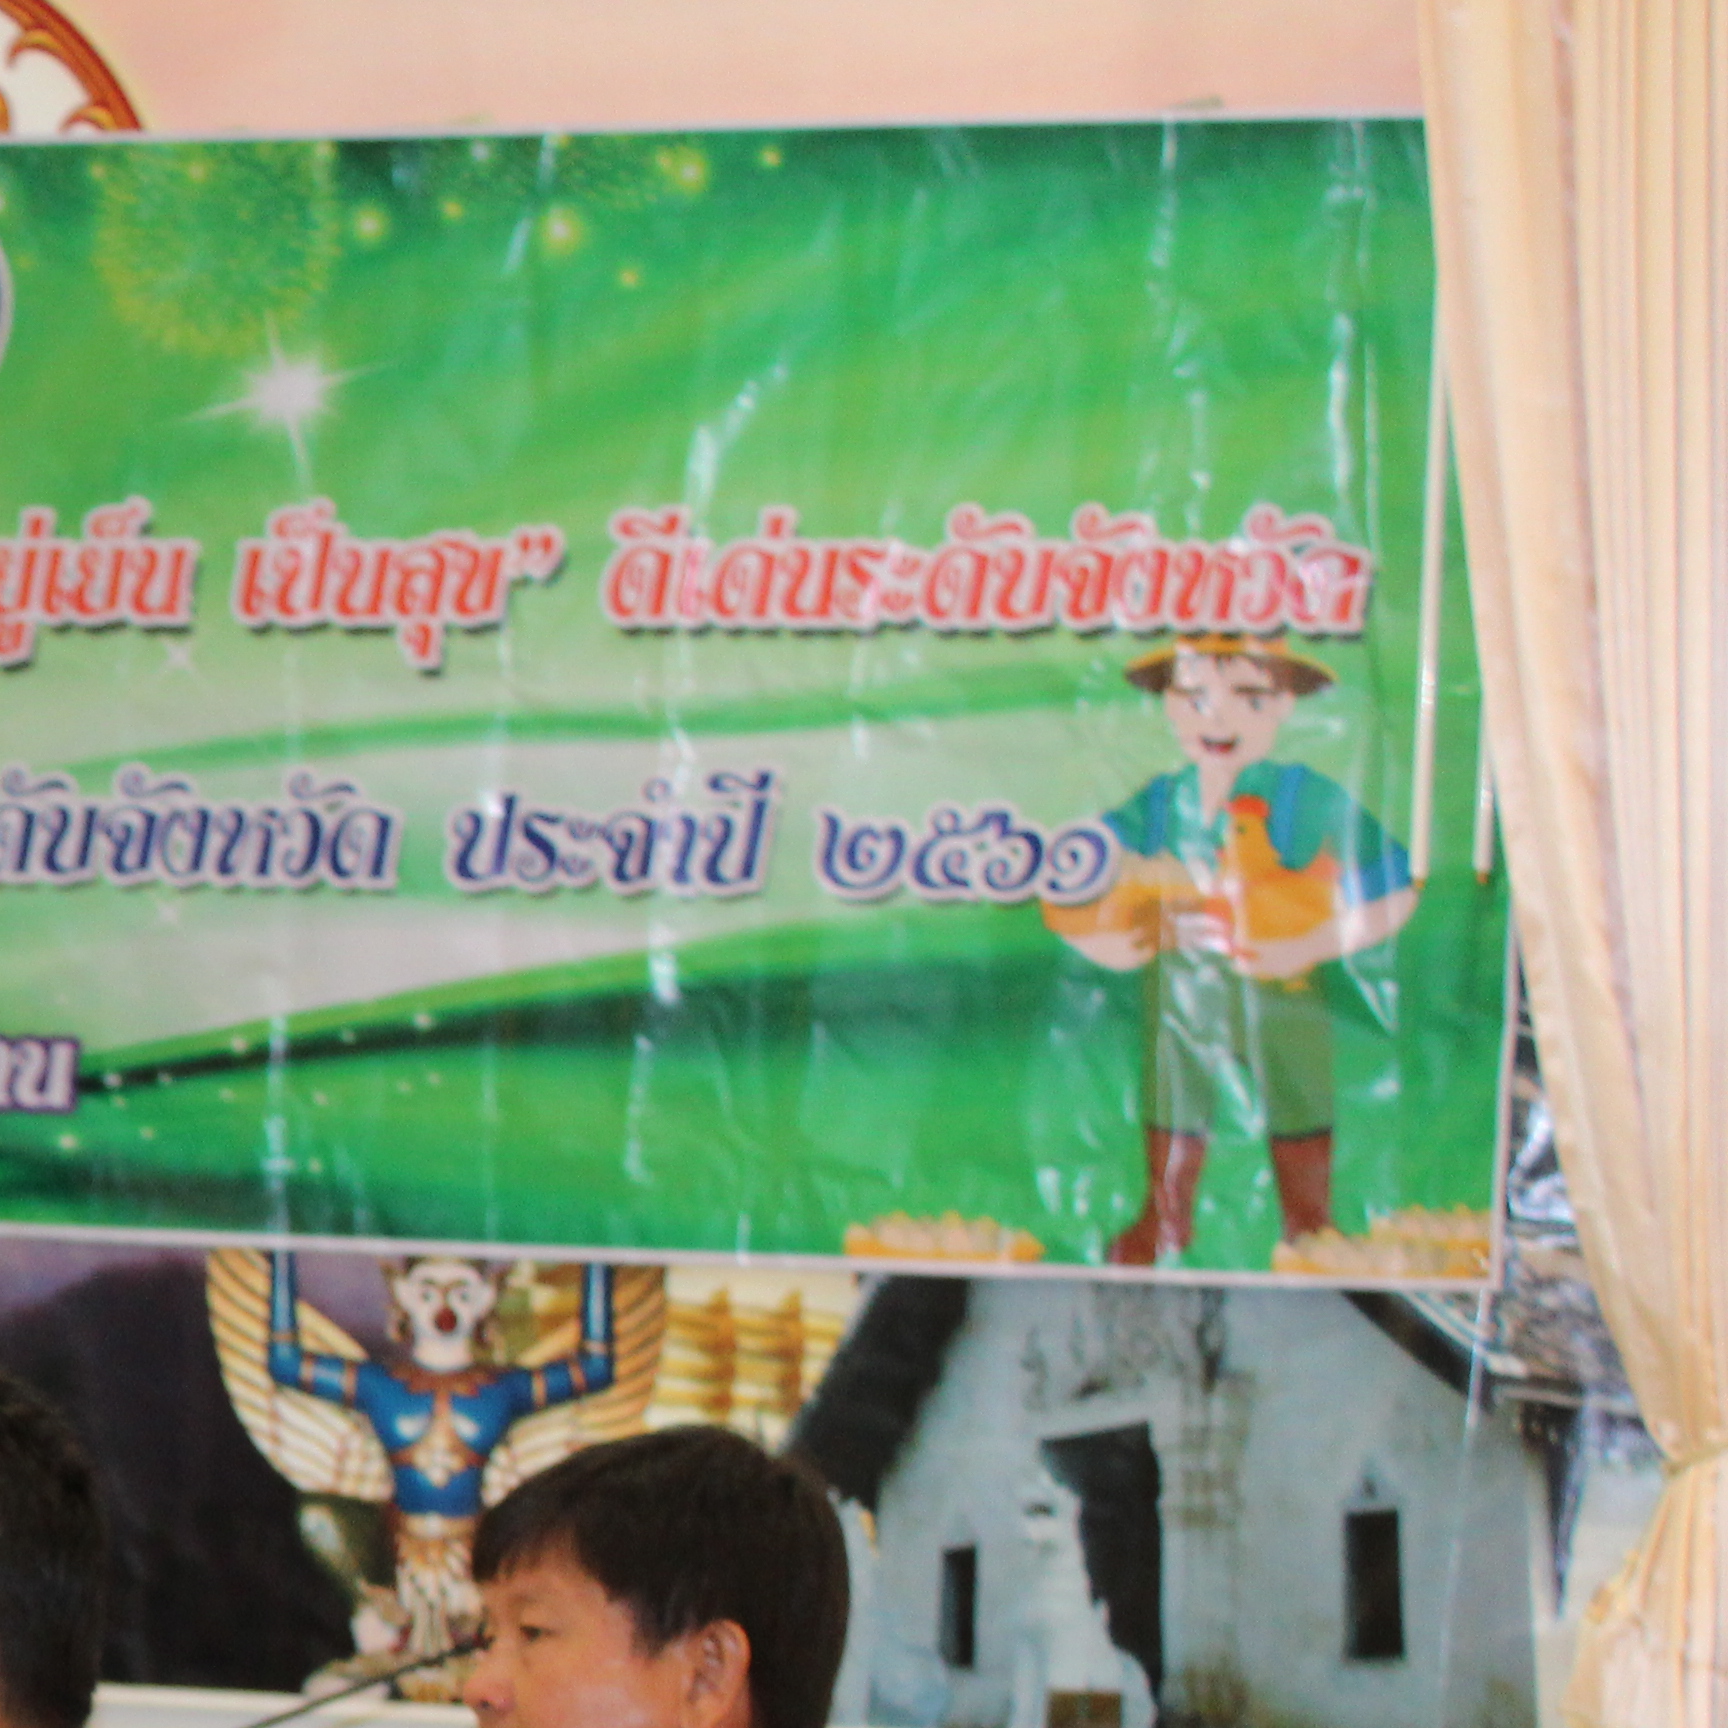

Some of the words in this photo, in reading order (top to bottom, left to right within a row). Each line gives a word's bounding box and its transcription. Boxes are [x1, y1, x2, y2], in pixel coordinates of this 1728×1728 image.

[605, 504, 1372, 634] ดีเด่นระดับจังหวัด
[449, 770, 775, 895] ประจำปี
[817, 806, 1114, 903] ๒๕๖๑
